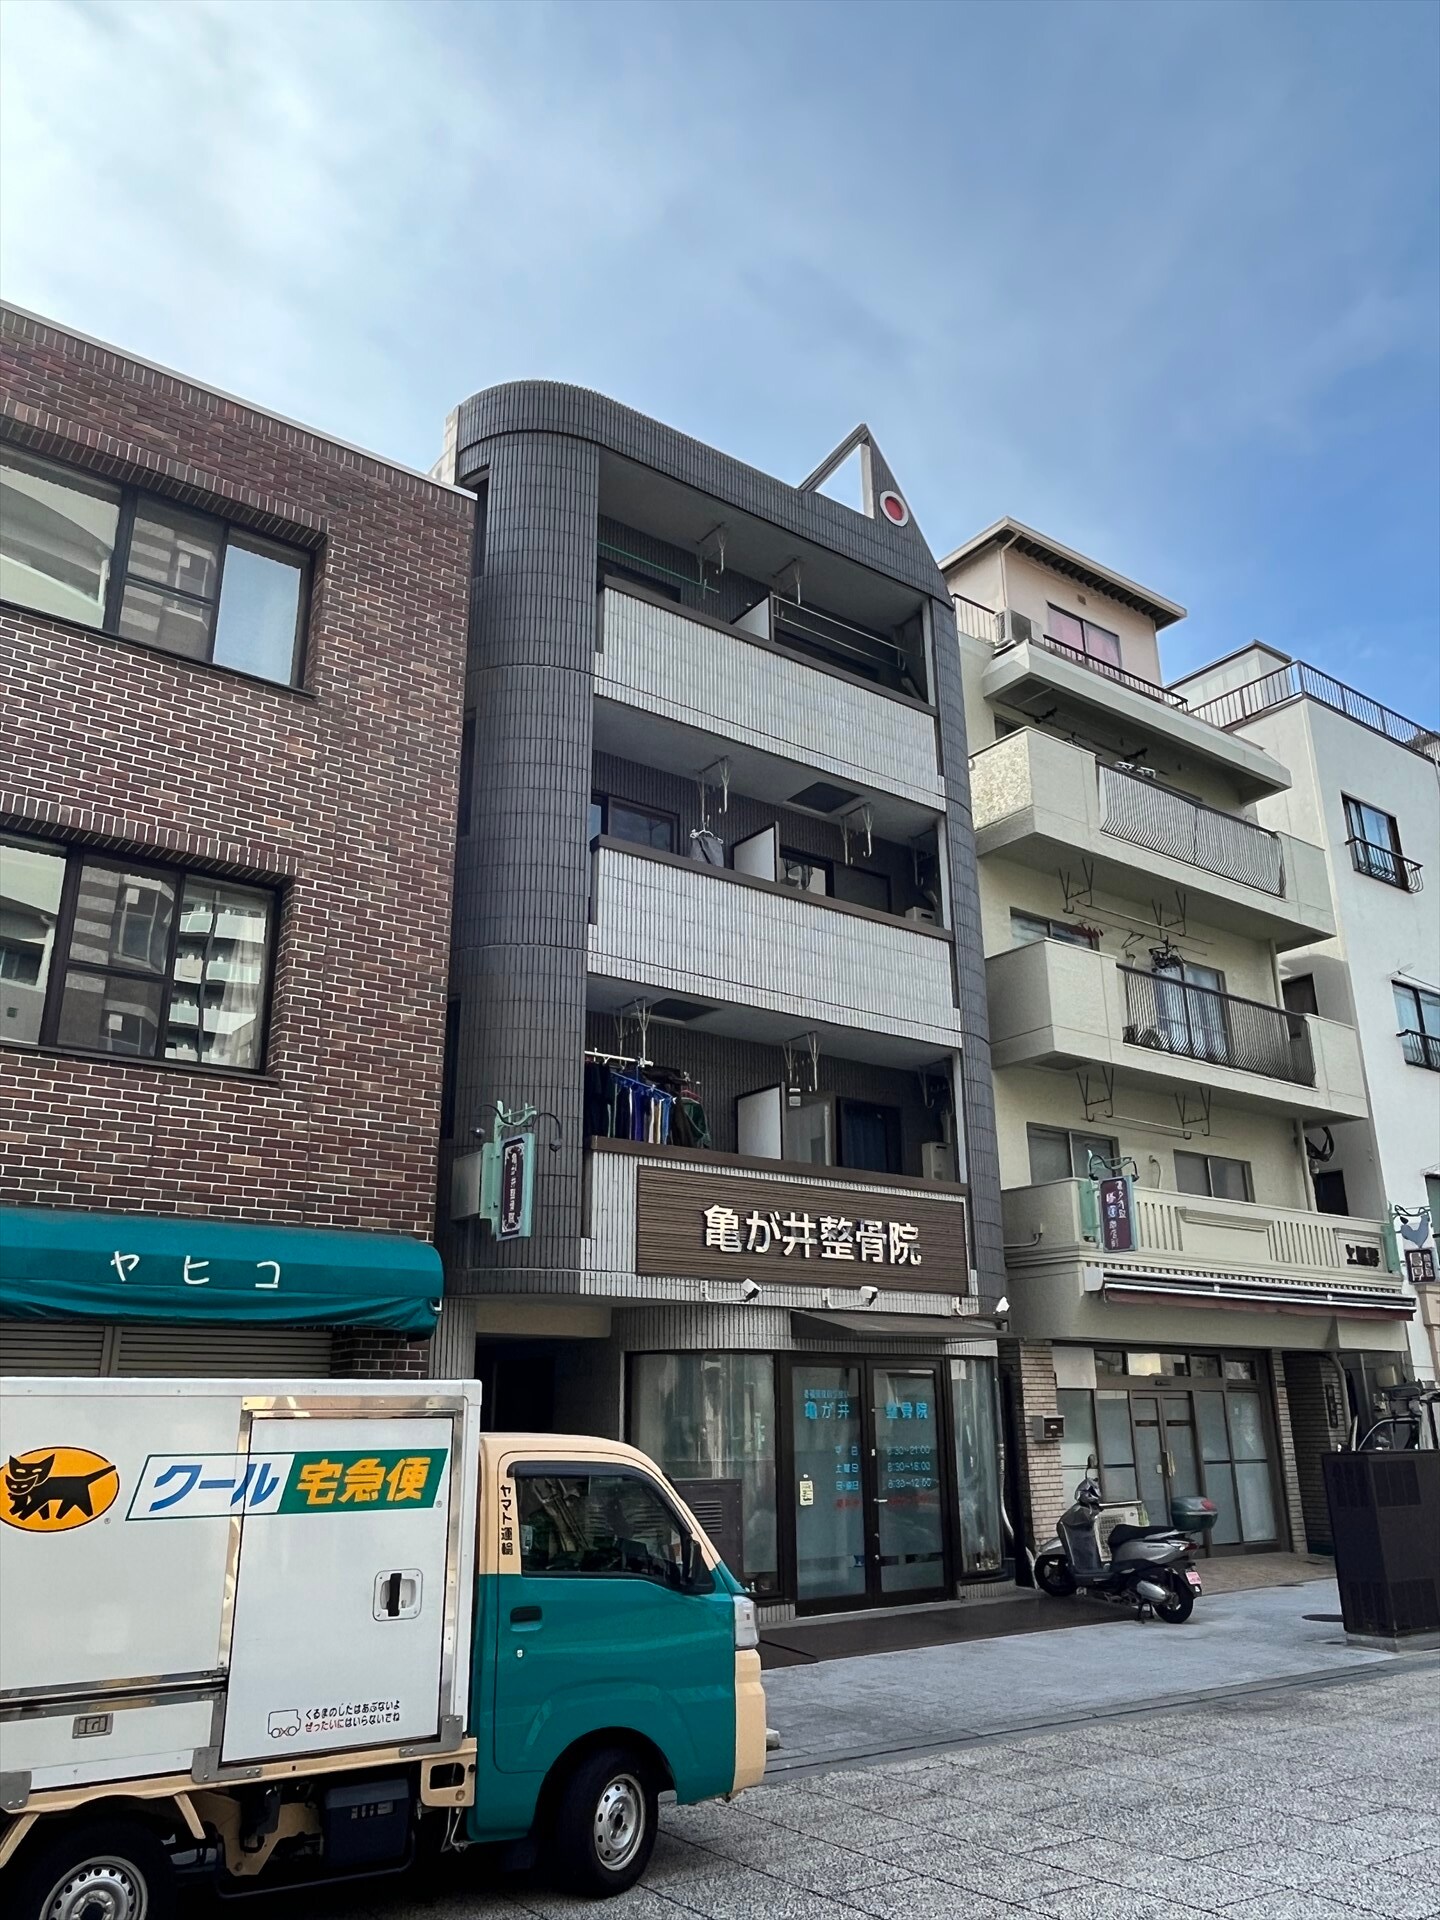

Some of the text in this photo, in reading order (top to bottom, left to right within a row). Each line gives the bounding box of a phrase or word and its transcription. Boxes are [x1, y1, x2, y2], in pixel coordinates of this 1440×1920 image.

[703, 1203, 922, 1266] 亀が井整骨院
[110, 1250, 281, 1289] ヤヒコ
[500, 1484, 513, 1554] ヤマト運輸
[306, 1700, 400, 1720] くるまのしたはあぶないよ
